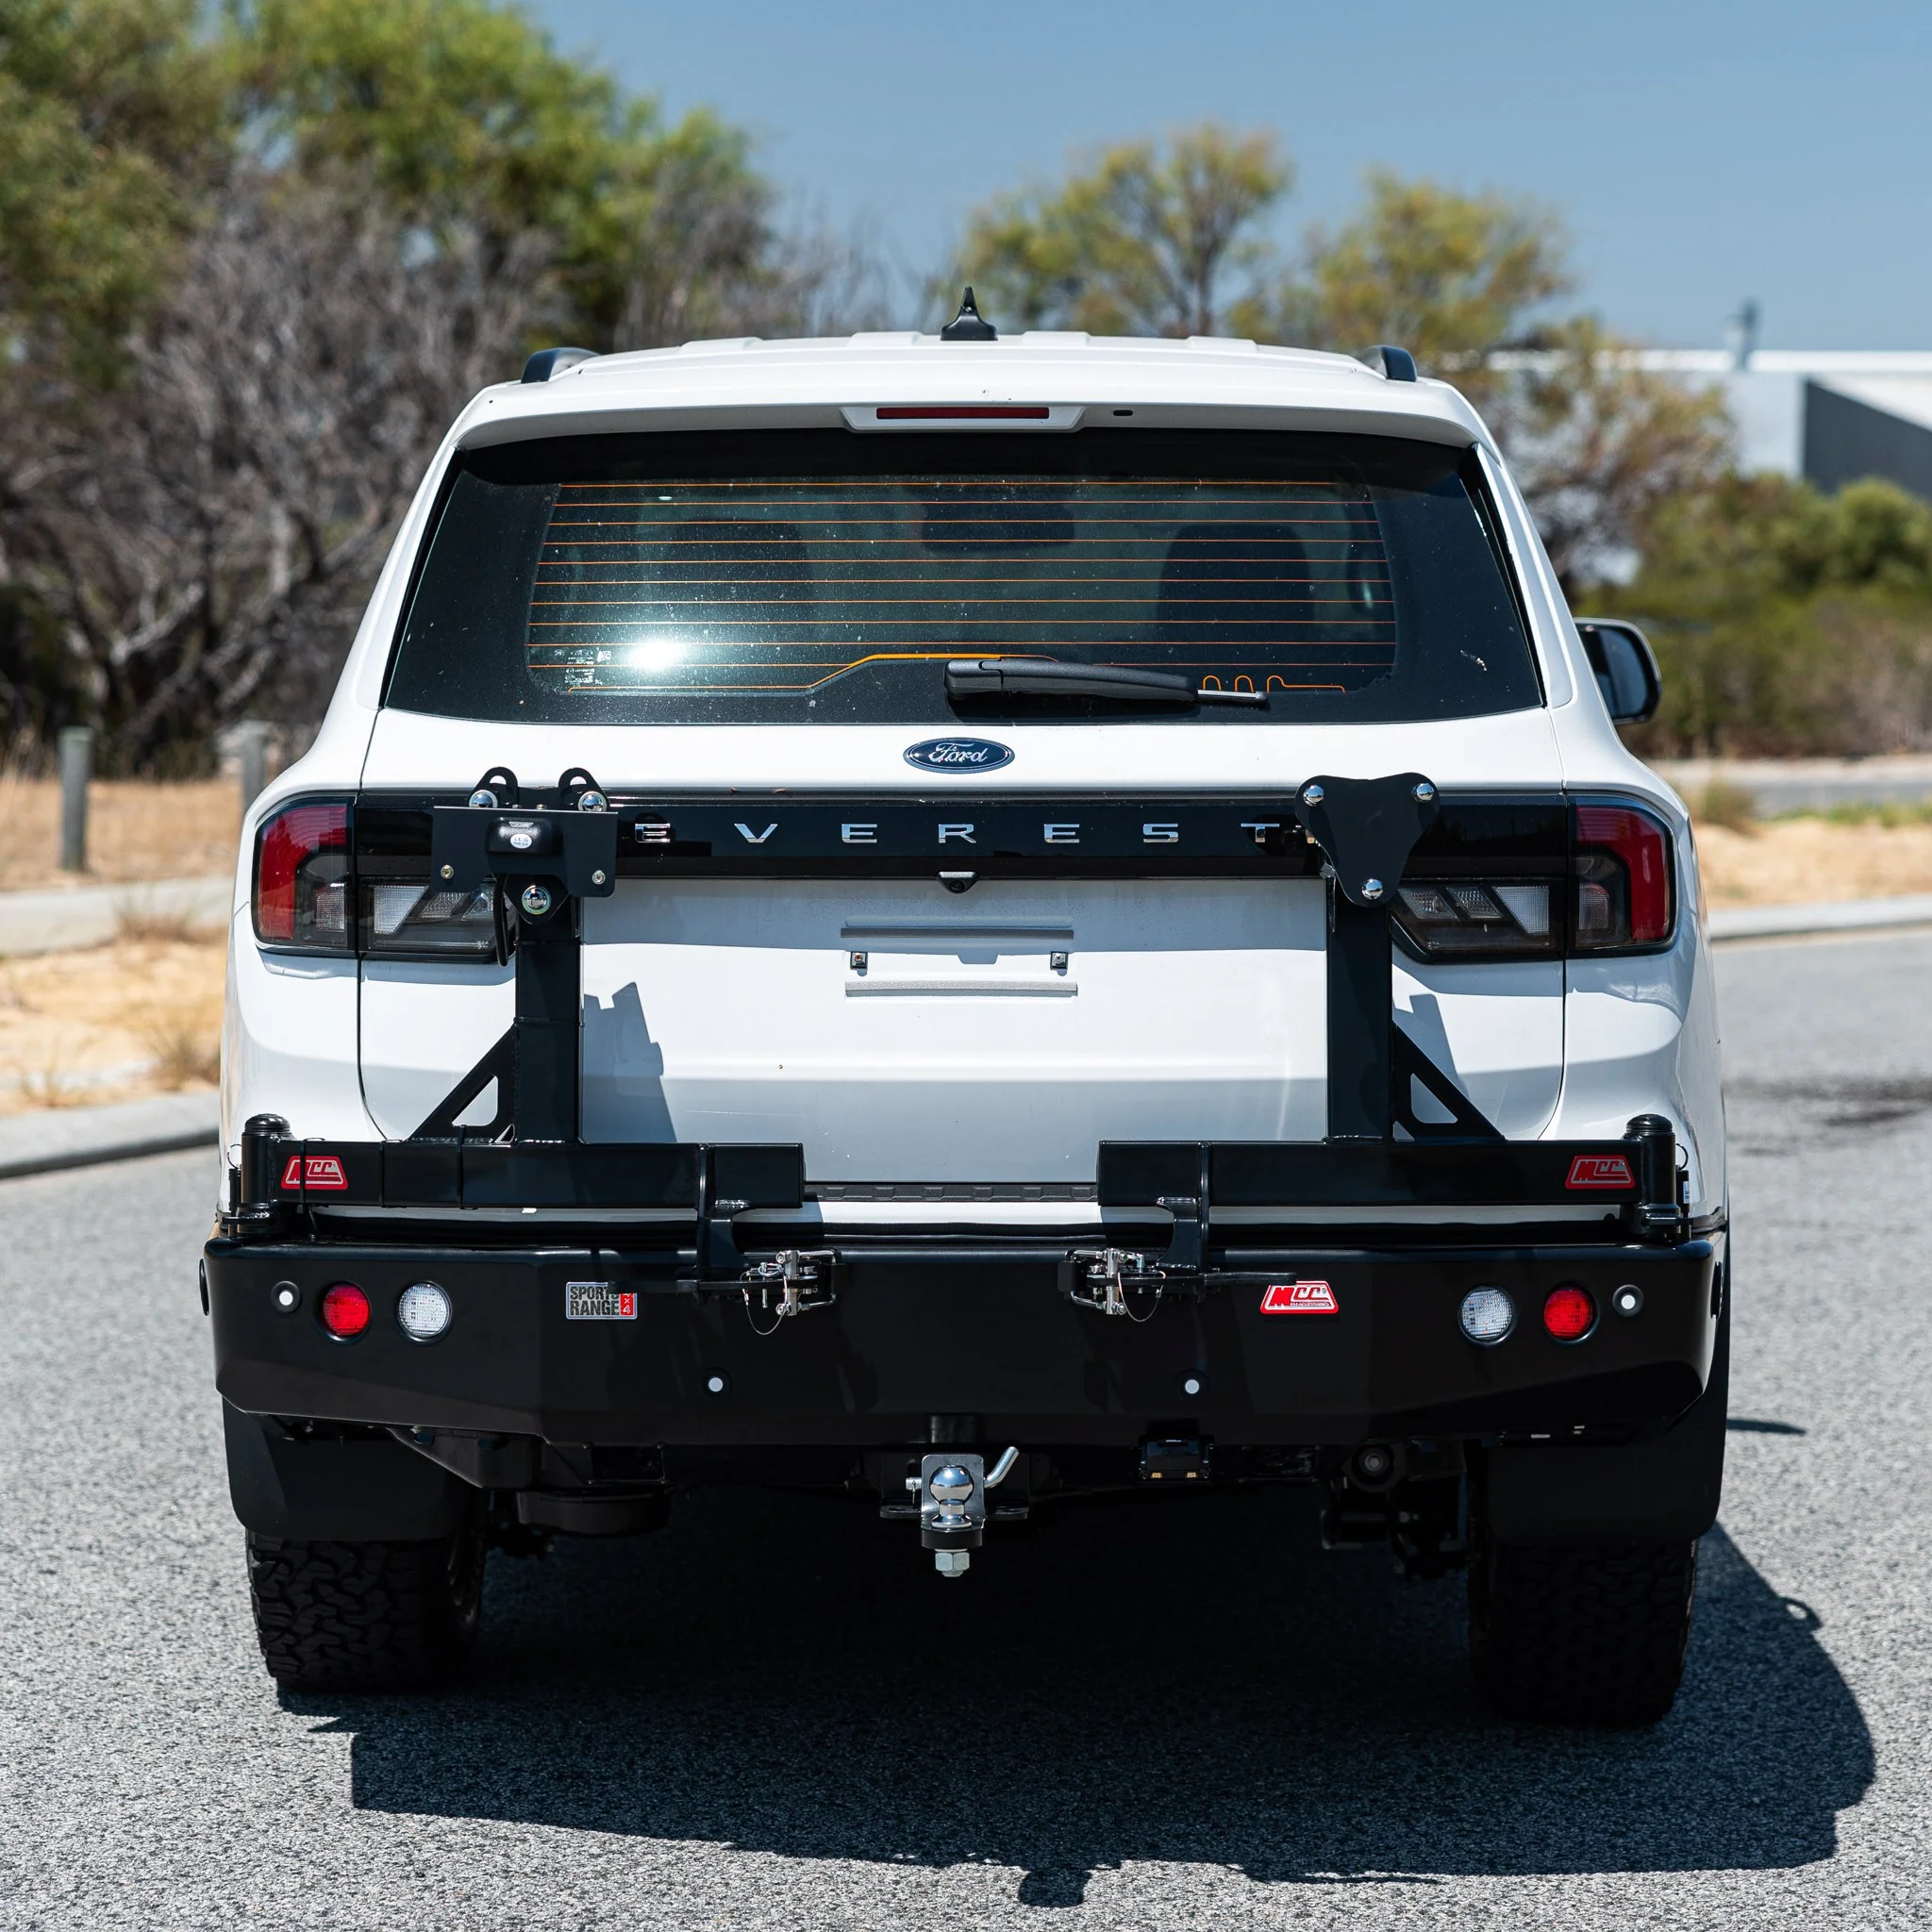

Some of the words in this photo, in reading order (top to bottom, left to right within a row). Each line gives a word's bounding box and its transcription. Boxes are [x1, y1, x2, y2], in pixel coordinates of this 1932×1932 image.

[928, 741, 989, 762] Ford
[634, 823, 1280, 843] EVEREST
[570, 1300, 620, 1316] RANGE
